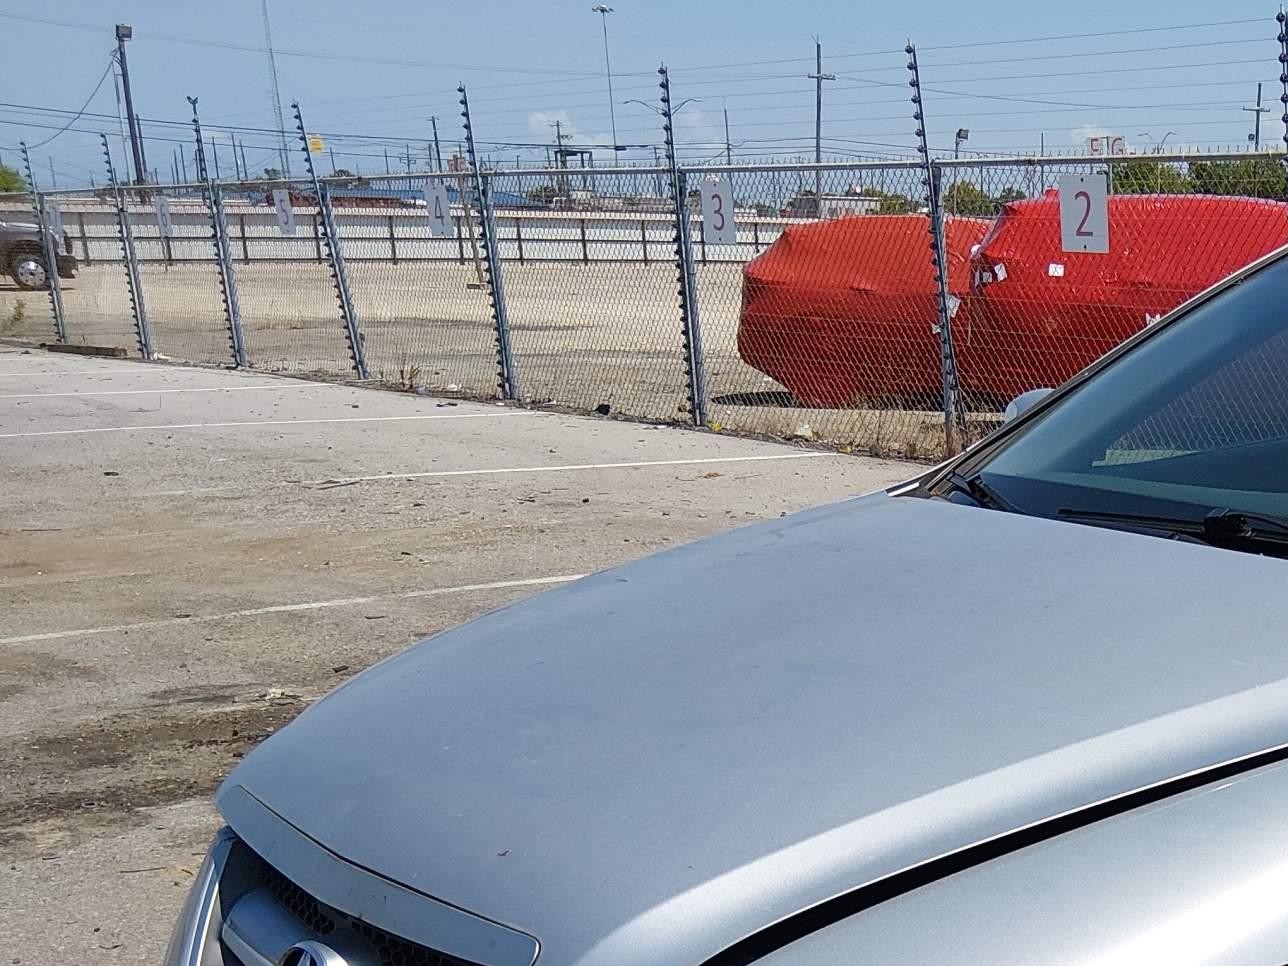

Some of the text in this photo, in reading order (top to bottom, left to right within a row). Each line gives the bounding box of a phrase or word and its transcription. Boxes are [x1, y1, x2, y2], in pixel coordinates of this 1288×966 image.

[279, 198, 289, 225] 5
[434, 195, 445, 227] 4
[711, 193, 725, 231] 3
[1074, 190, 1094, 237] 2
